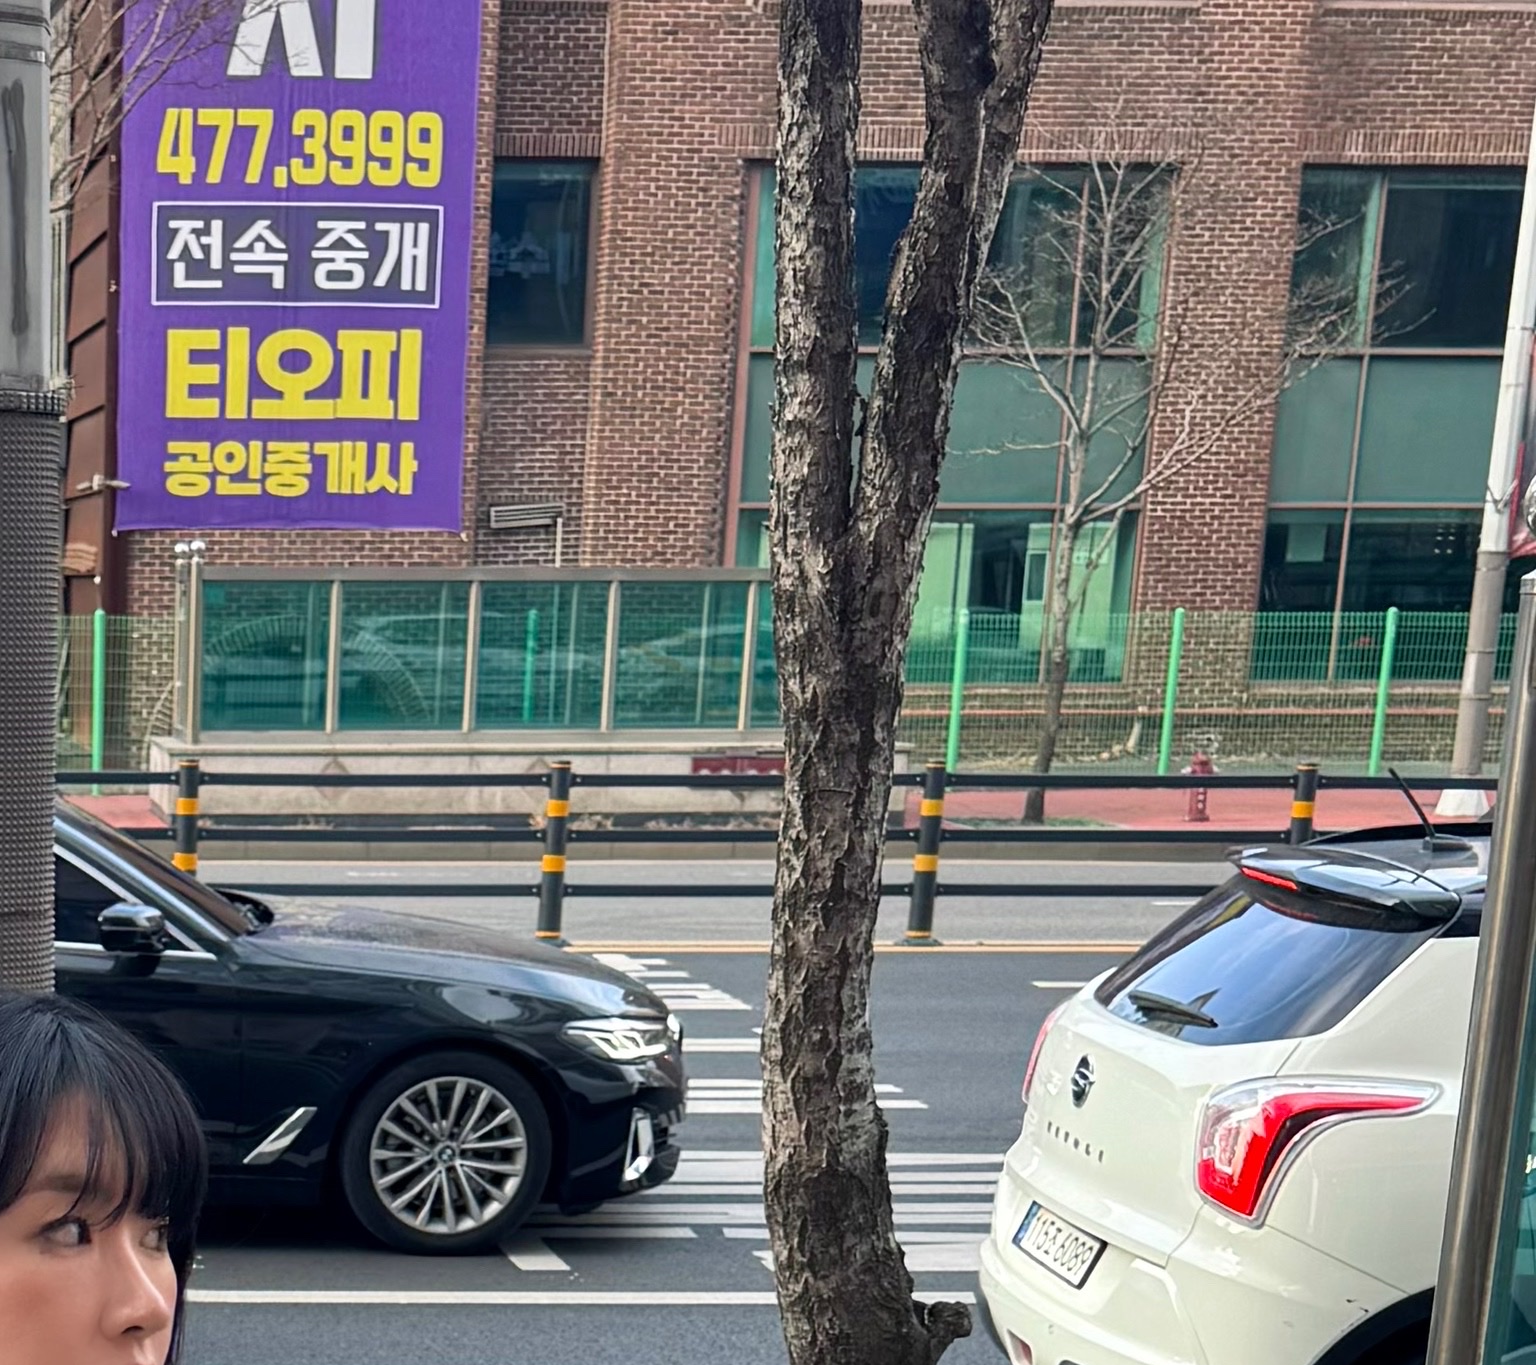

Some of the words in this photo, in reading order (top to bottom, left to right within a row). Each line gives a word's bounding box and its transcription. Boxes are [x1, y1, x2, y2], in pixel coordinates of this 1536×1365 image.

[157, 108, 443, 188] 477.3999
[166, 219, 289, 289] 전속
[311, 220, 430, 291] 중개
[165, 327, 423, 421] 티오피
[164, 440, 418, 497] 공인중개사
